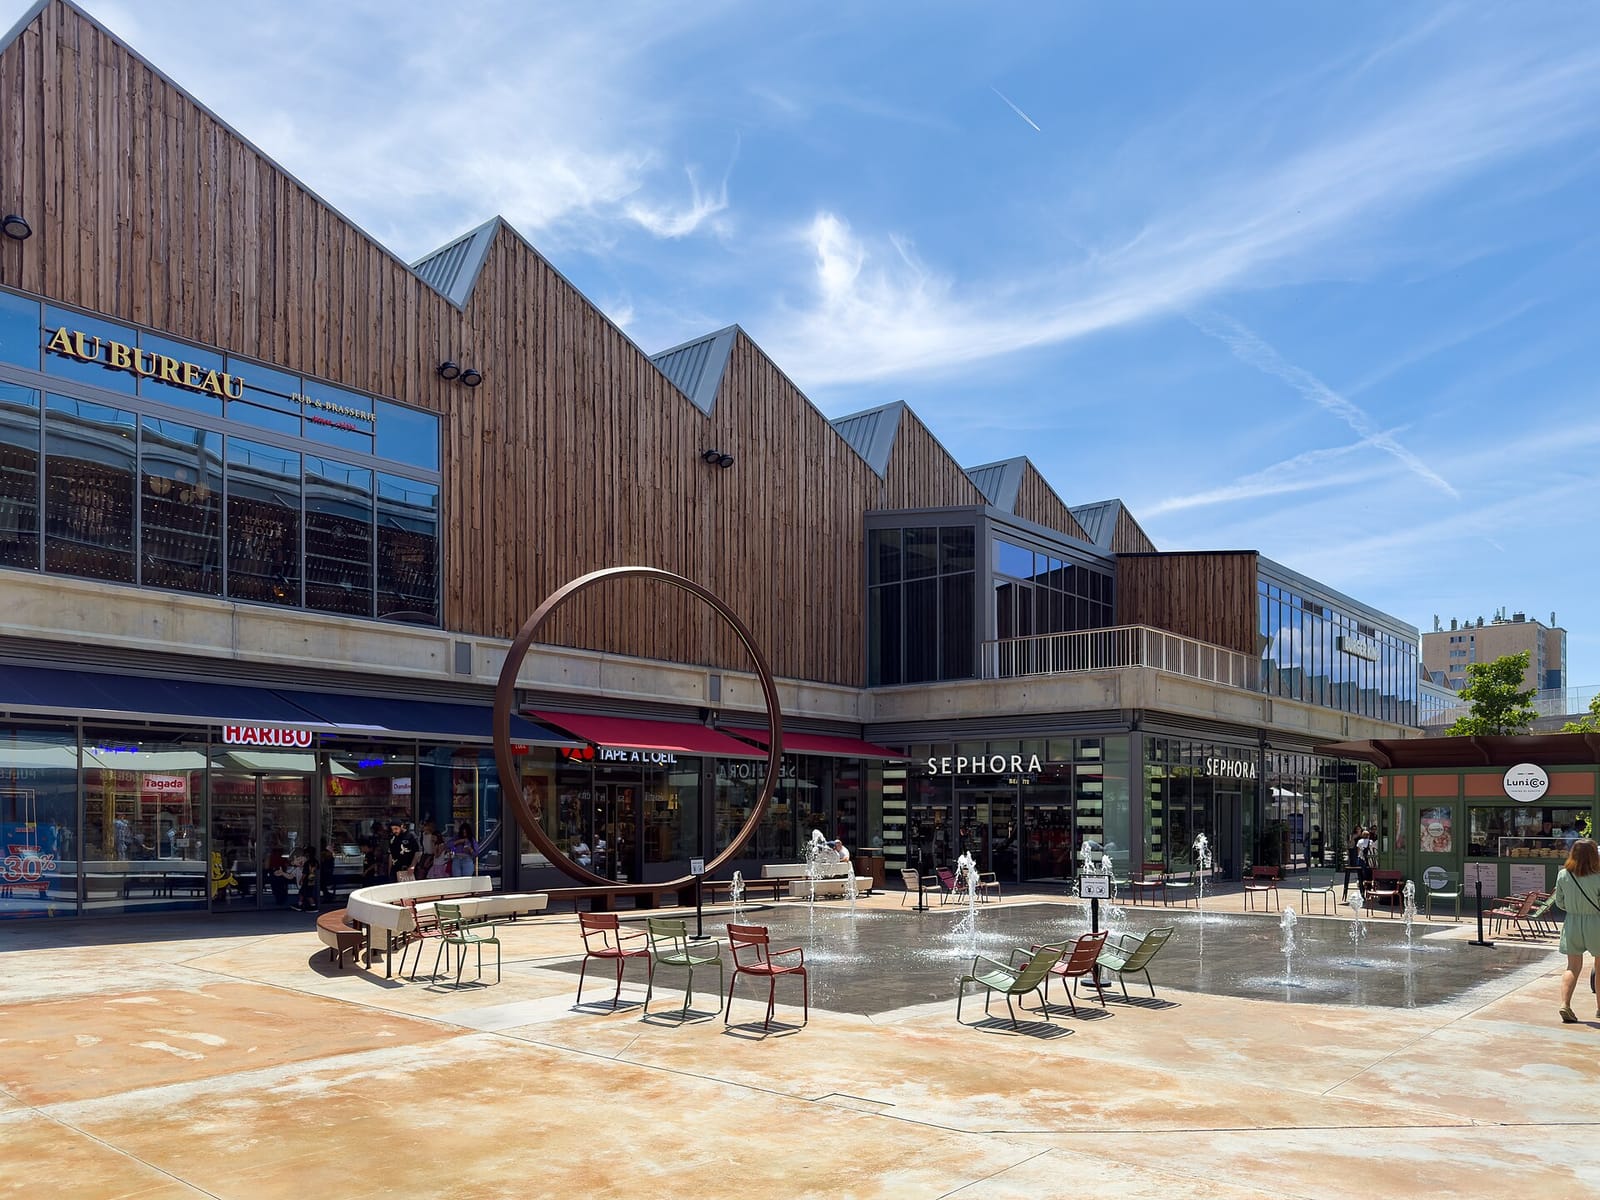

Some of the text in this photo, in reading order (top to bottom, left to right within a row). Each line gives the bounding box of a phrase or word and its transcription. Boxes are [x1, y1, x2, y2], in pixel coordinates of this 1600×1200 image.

[48, 327, 246, 400] AU BUREAU
[292, 392, 376, 421] PUB & BRASSERIE
[223, 725, 312, 748] HARIBO
[927, 754, 1042, 775] SEPHORA
[1206, 757, 1256, 779] SEPHORA
[144, 779, 184, 790] Tagada
